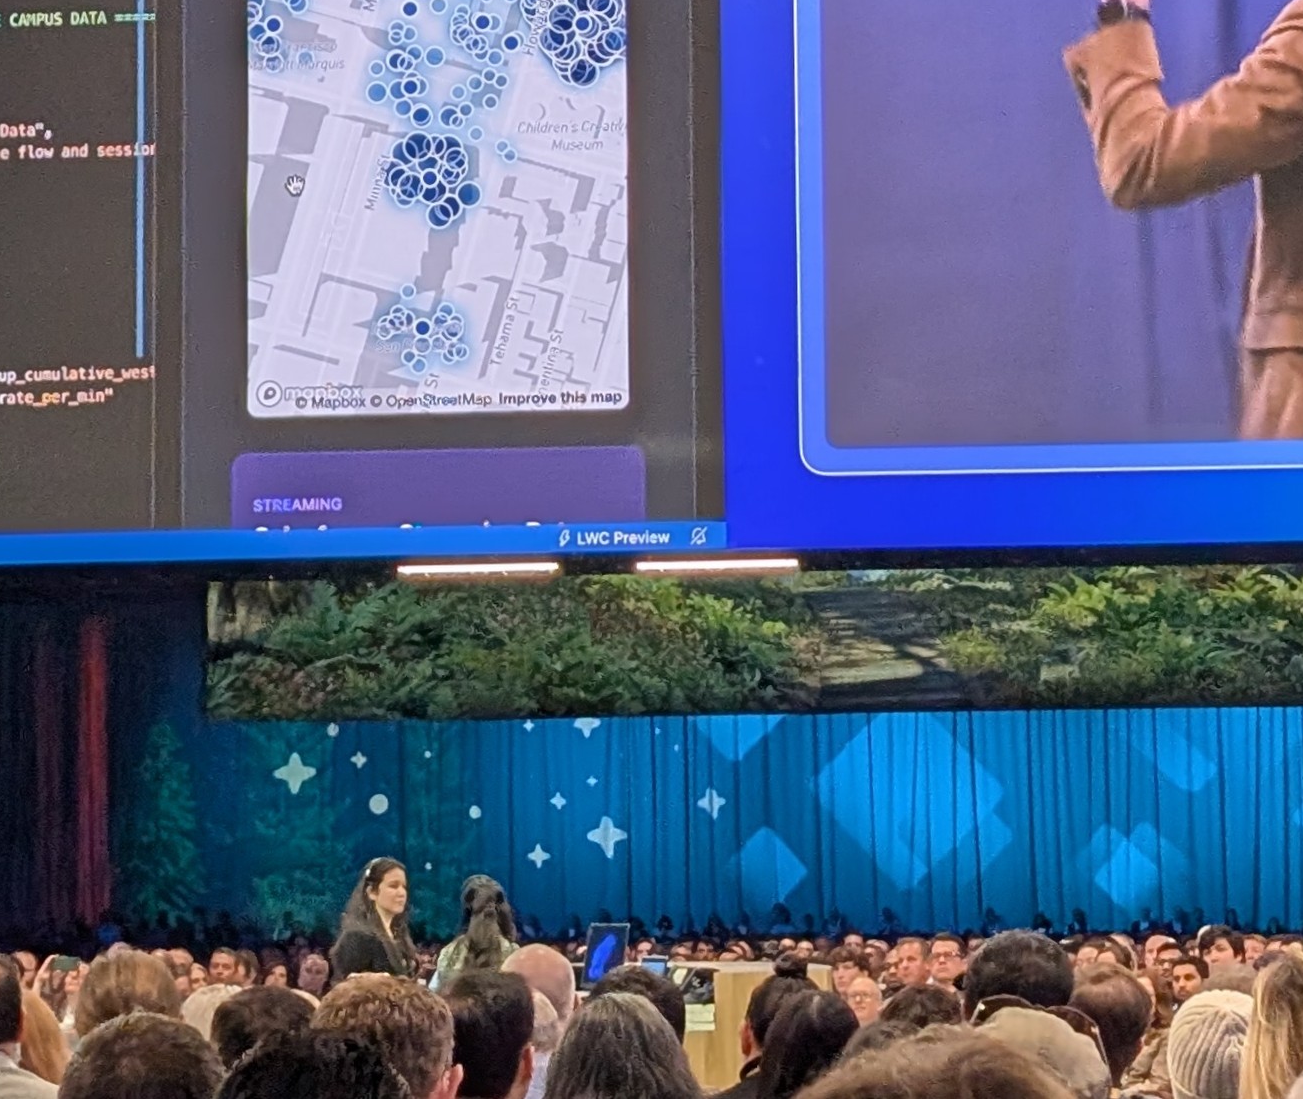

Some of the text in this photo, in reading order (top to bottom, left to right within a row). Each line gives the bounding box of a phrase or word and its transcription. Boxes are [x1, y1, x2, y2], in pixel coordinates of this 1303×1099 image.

[9, 12, 62, 27] CAMPUS
[70, 10, 107, 25] DATA
[312, 396, 366, 409] Mapbox
[499, 392, 556, 406] Improve
[561, 391, 587, 404] this
[592, 391, 622, 404] map
[252, 497, 342, 512] STREAMING
[577, 531, 670, 545] LWC Preview
